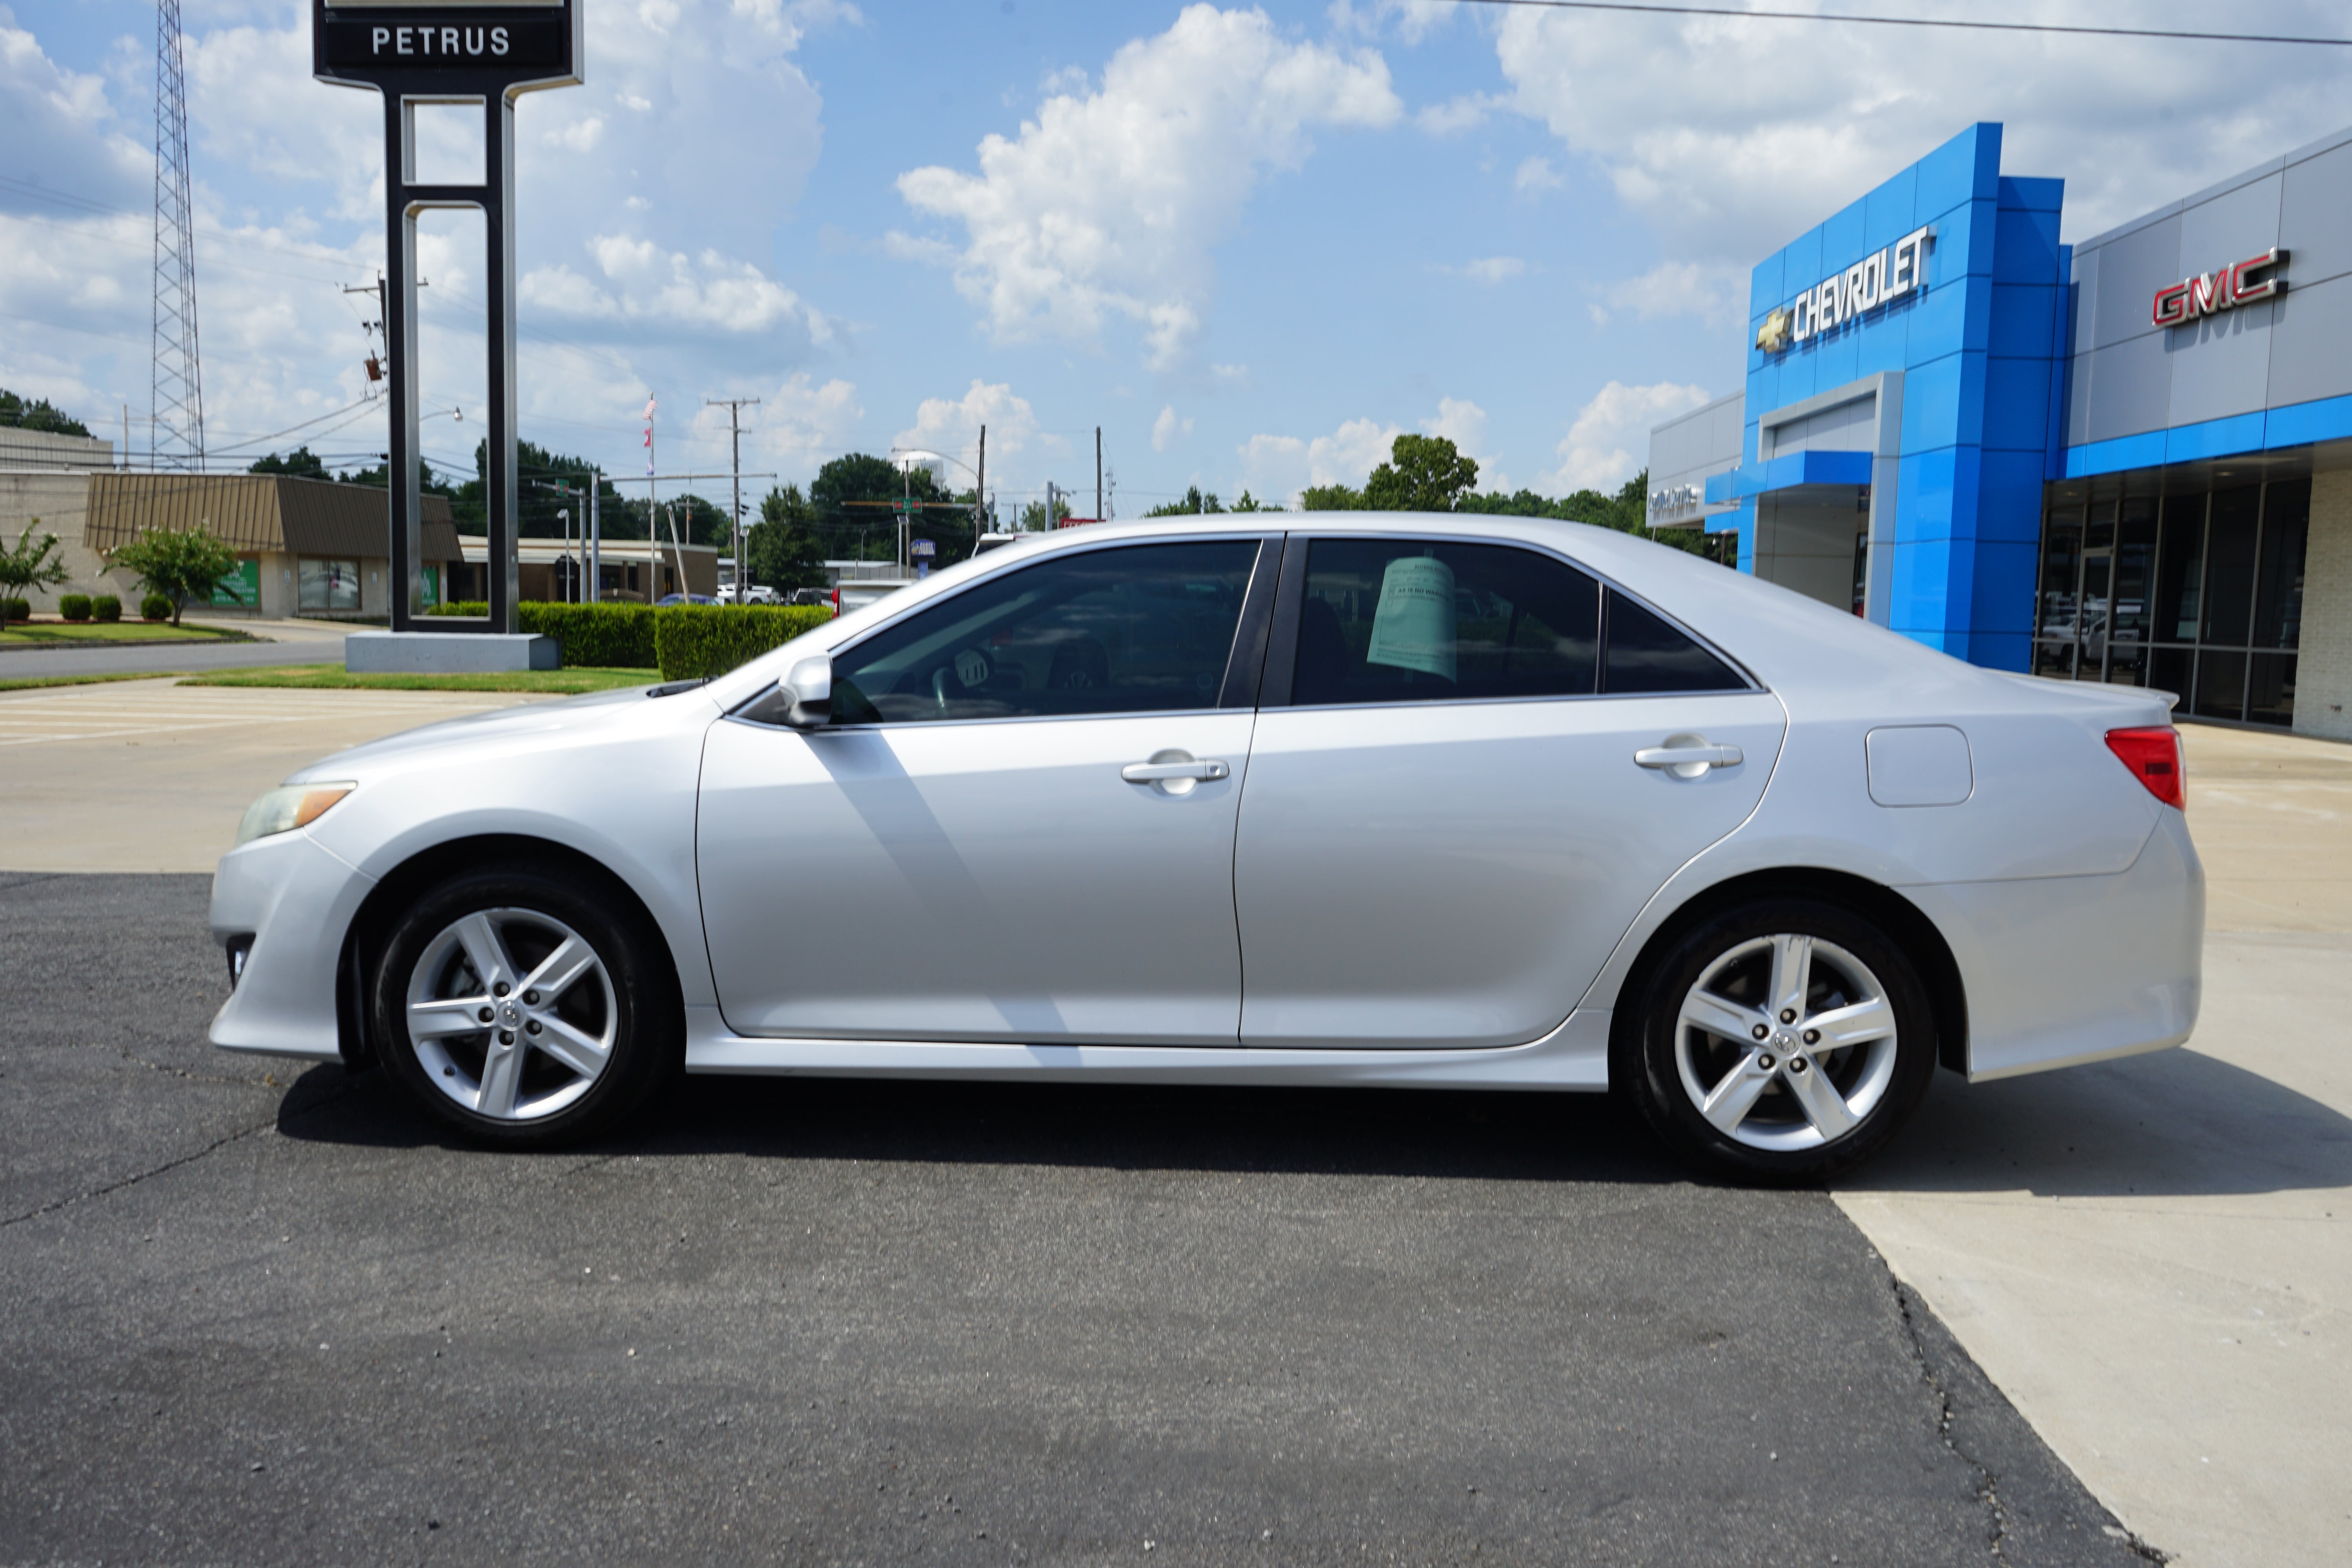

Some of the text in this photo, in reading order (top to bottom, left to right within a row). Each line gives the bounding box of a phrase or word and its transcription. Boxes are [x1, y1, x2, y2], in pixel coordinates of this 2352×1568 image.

[372, 27, 509, 56] PETRUS
[1793, 225, 1929, 343] CHEVROLET
[2152, 247, 2279, 327] GMC
